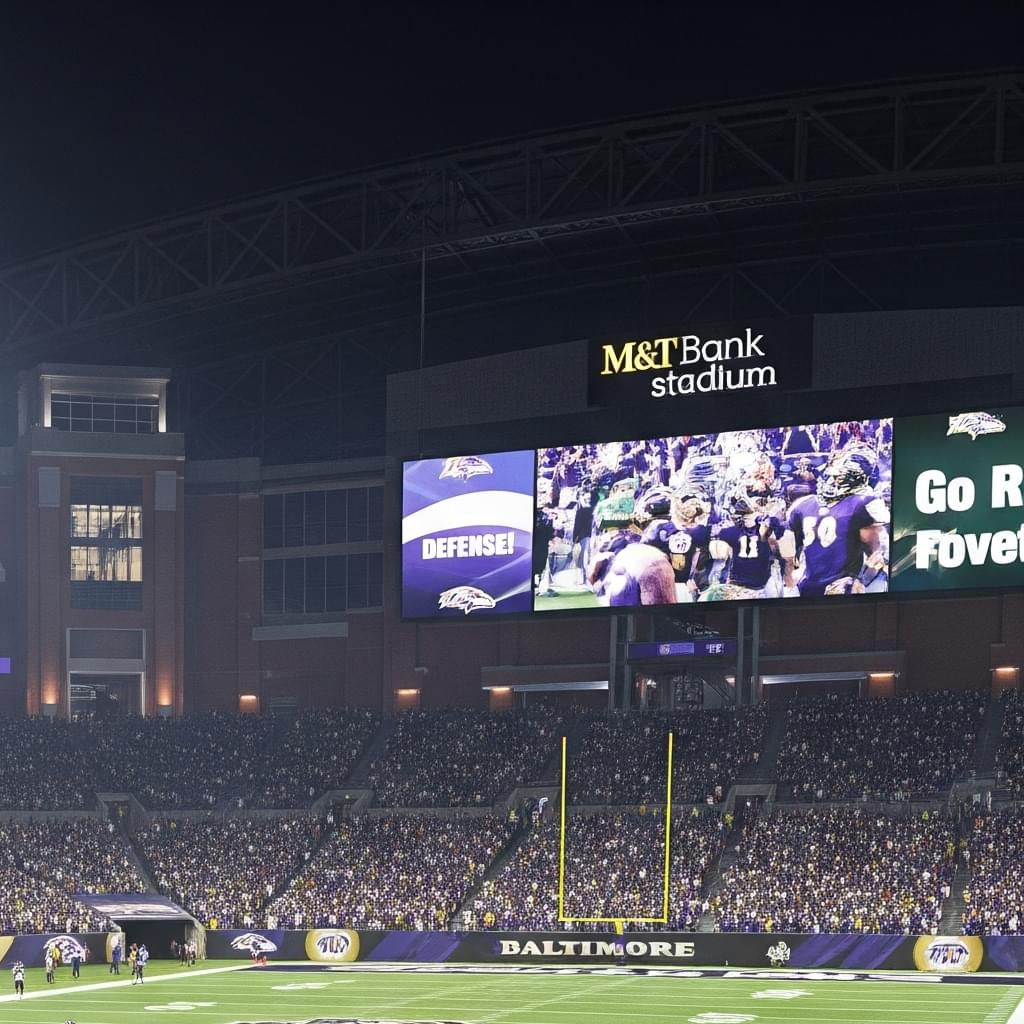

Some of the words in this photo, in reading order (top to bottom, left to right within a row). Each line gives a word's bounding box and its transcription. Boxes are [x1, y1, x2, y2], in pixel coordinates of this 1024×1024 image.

[601, 337, 678, 375] M&T
[680, 328, 765, 365] Bank
[651, 363, 777, 397] stadium
[915, 469, 975, 514] Go
[422, 532, 515, 560] DEFENSE!
[499, 940, 695, 957] BALTIMORE
